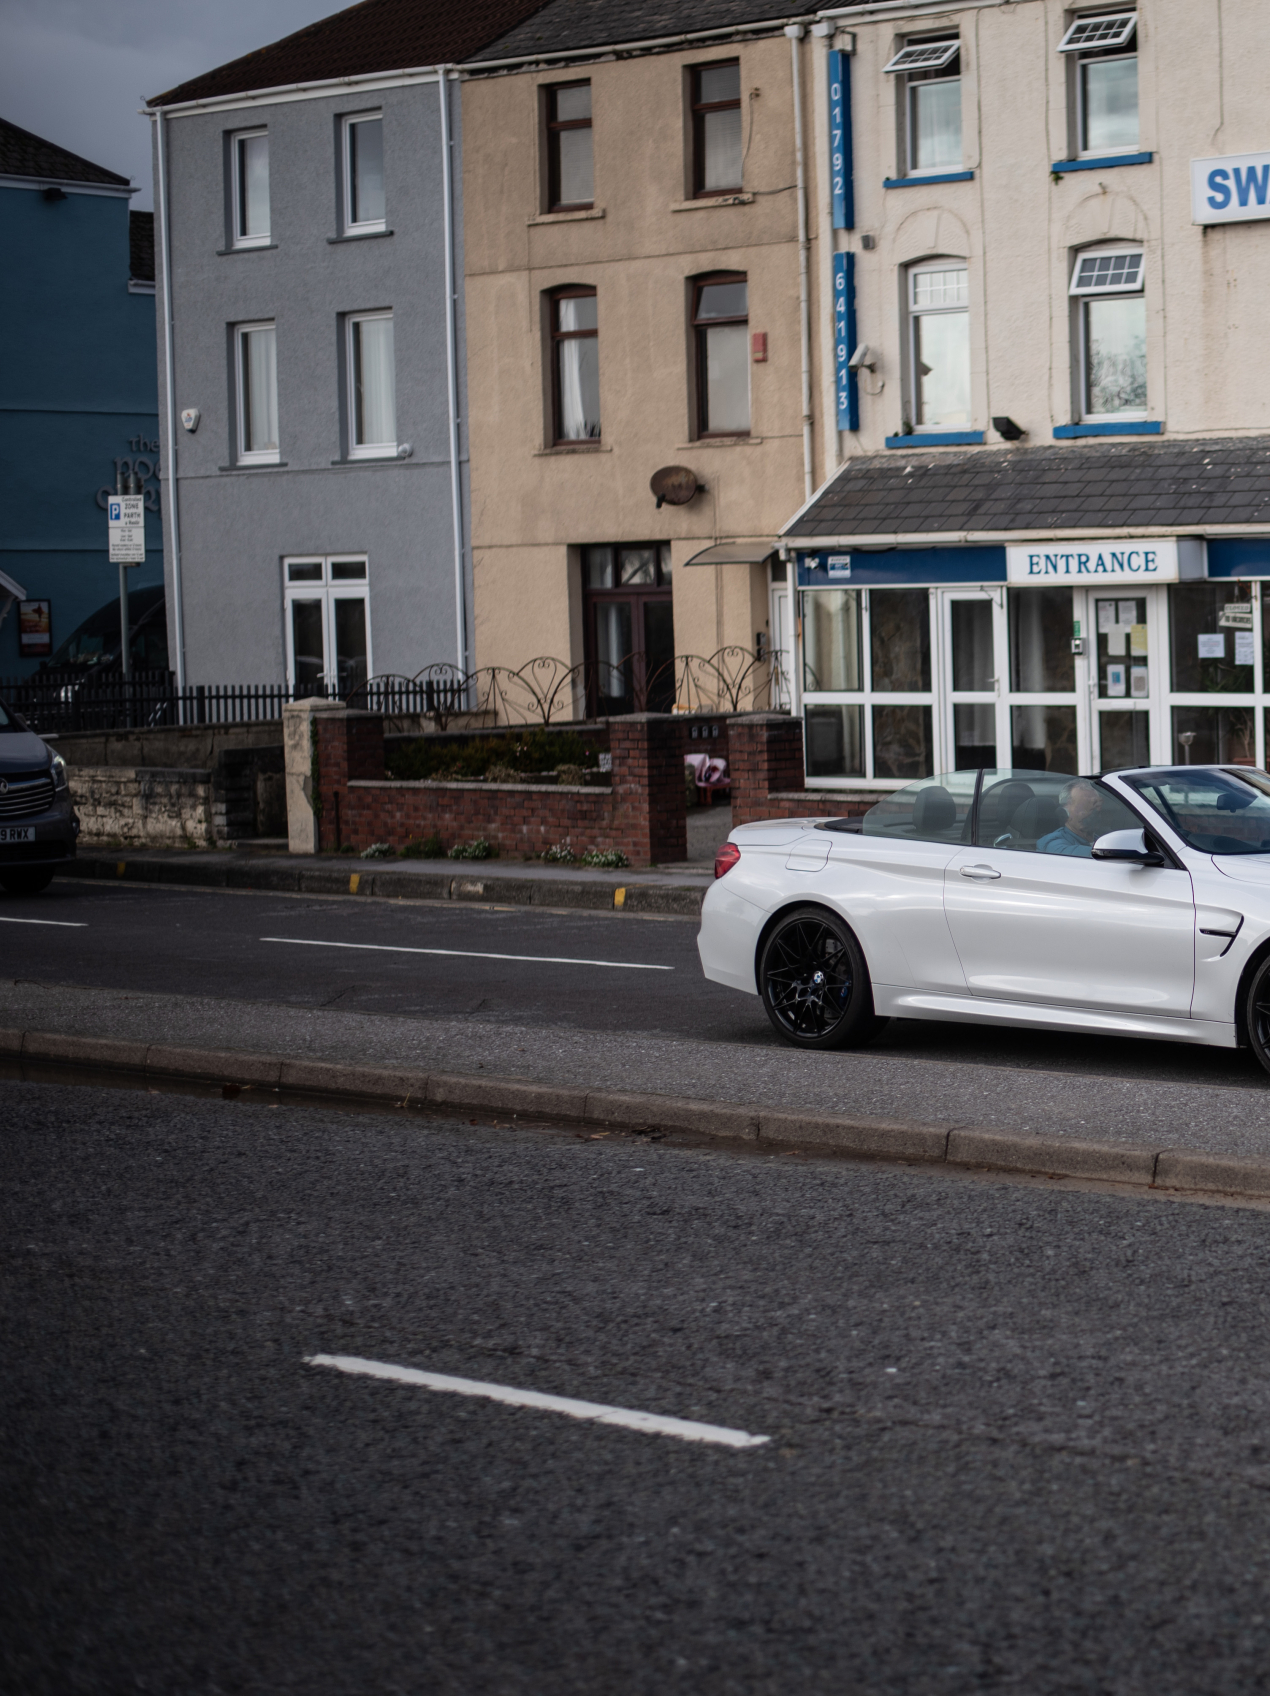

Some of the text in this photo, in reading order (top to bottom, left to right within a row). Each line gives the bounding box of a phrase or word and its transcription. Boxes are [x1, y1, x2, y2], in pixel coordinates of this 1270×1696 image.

[831, 82, 843, 195] 01792
[835, 272, 848, 410] 641913
[1028, 551, 1158, 575] ENTRANCE
[10, 828, 29, 840] RWX
